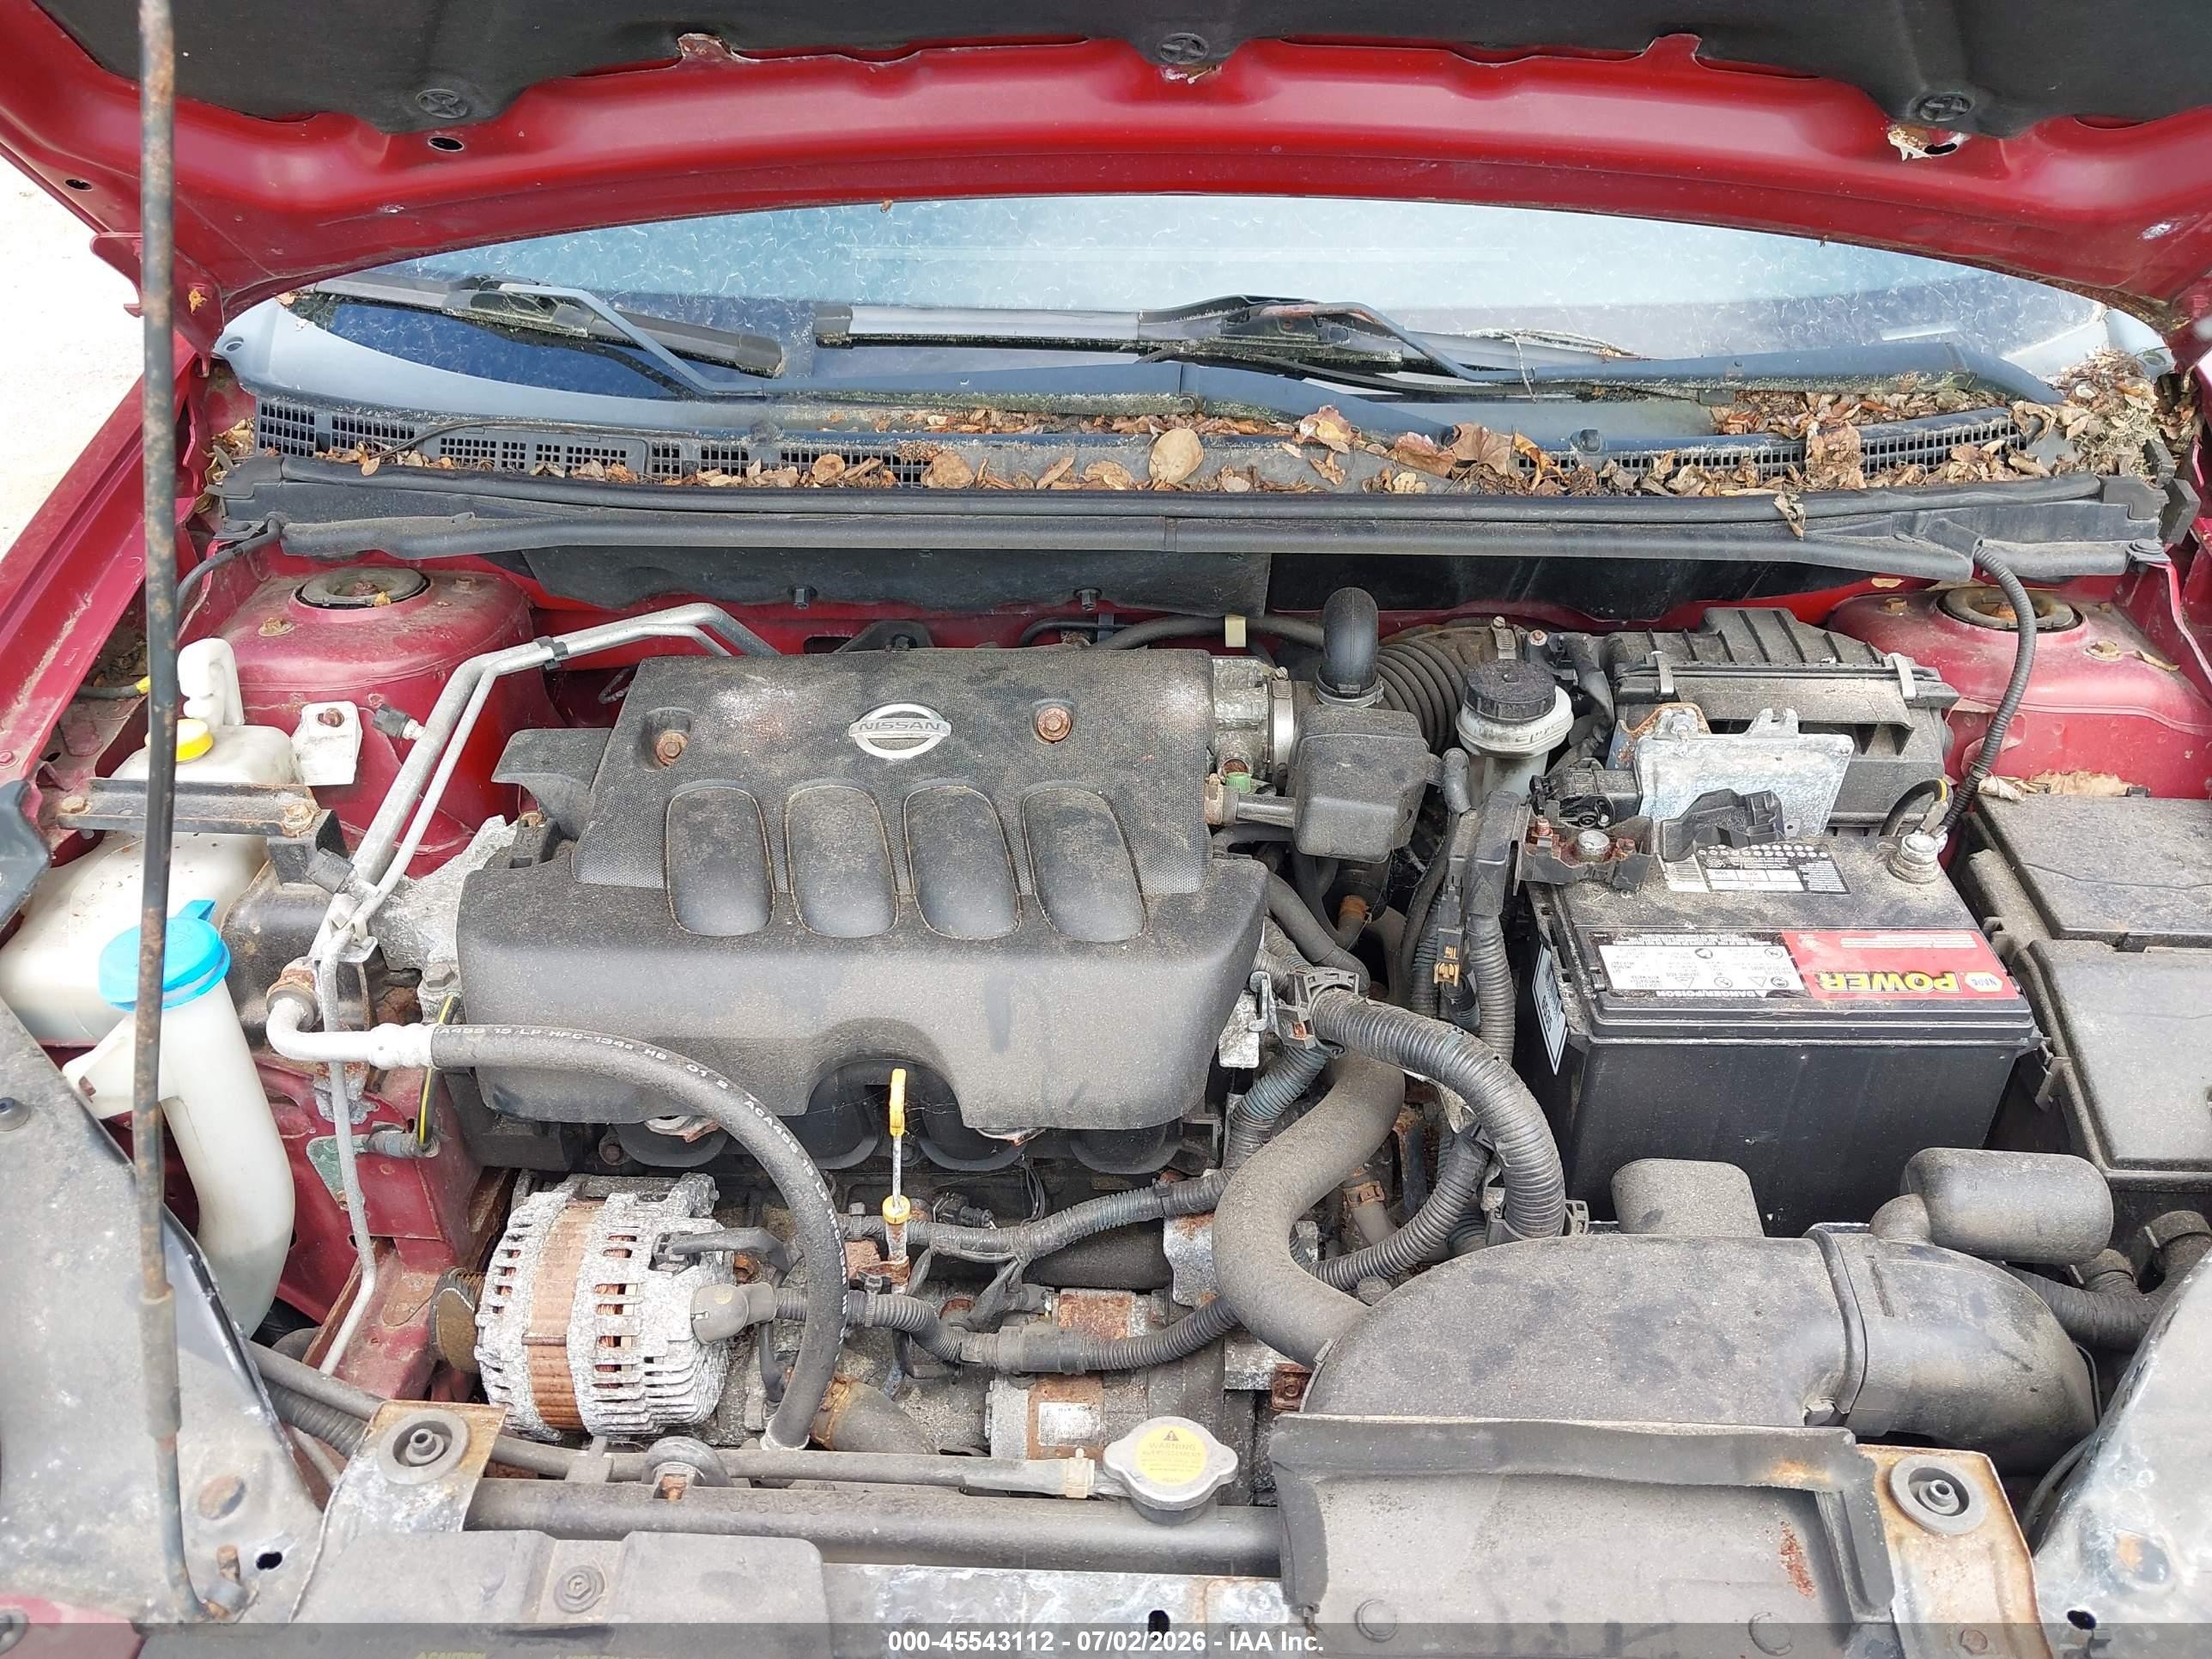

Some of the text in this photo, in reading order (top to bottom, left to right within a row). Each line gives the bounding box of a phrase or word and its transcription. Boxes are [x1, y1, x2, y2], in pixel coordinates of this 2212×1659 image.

[859, 720, 940, 731] NISSAN
[1818, 971, 1962, 993] POWER
[644, 1048, 667, 1060] HB
[815, 1181, 828, 1202] LP
[1149, 1442, 1196, 1451] WARNING
